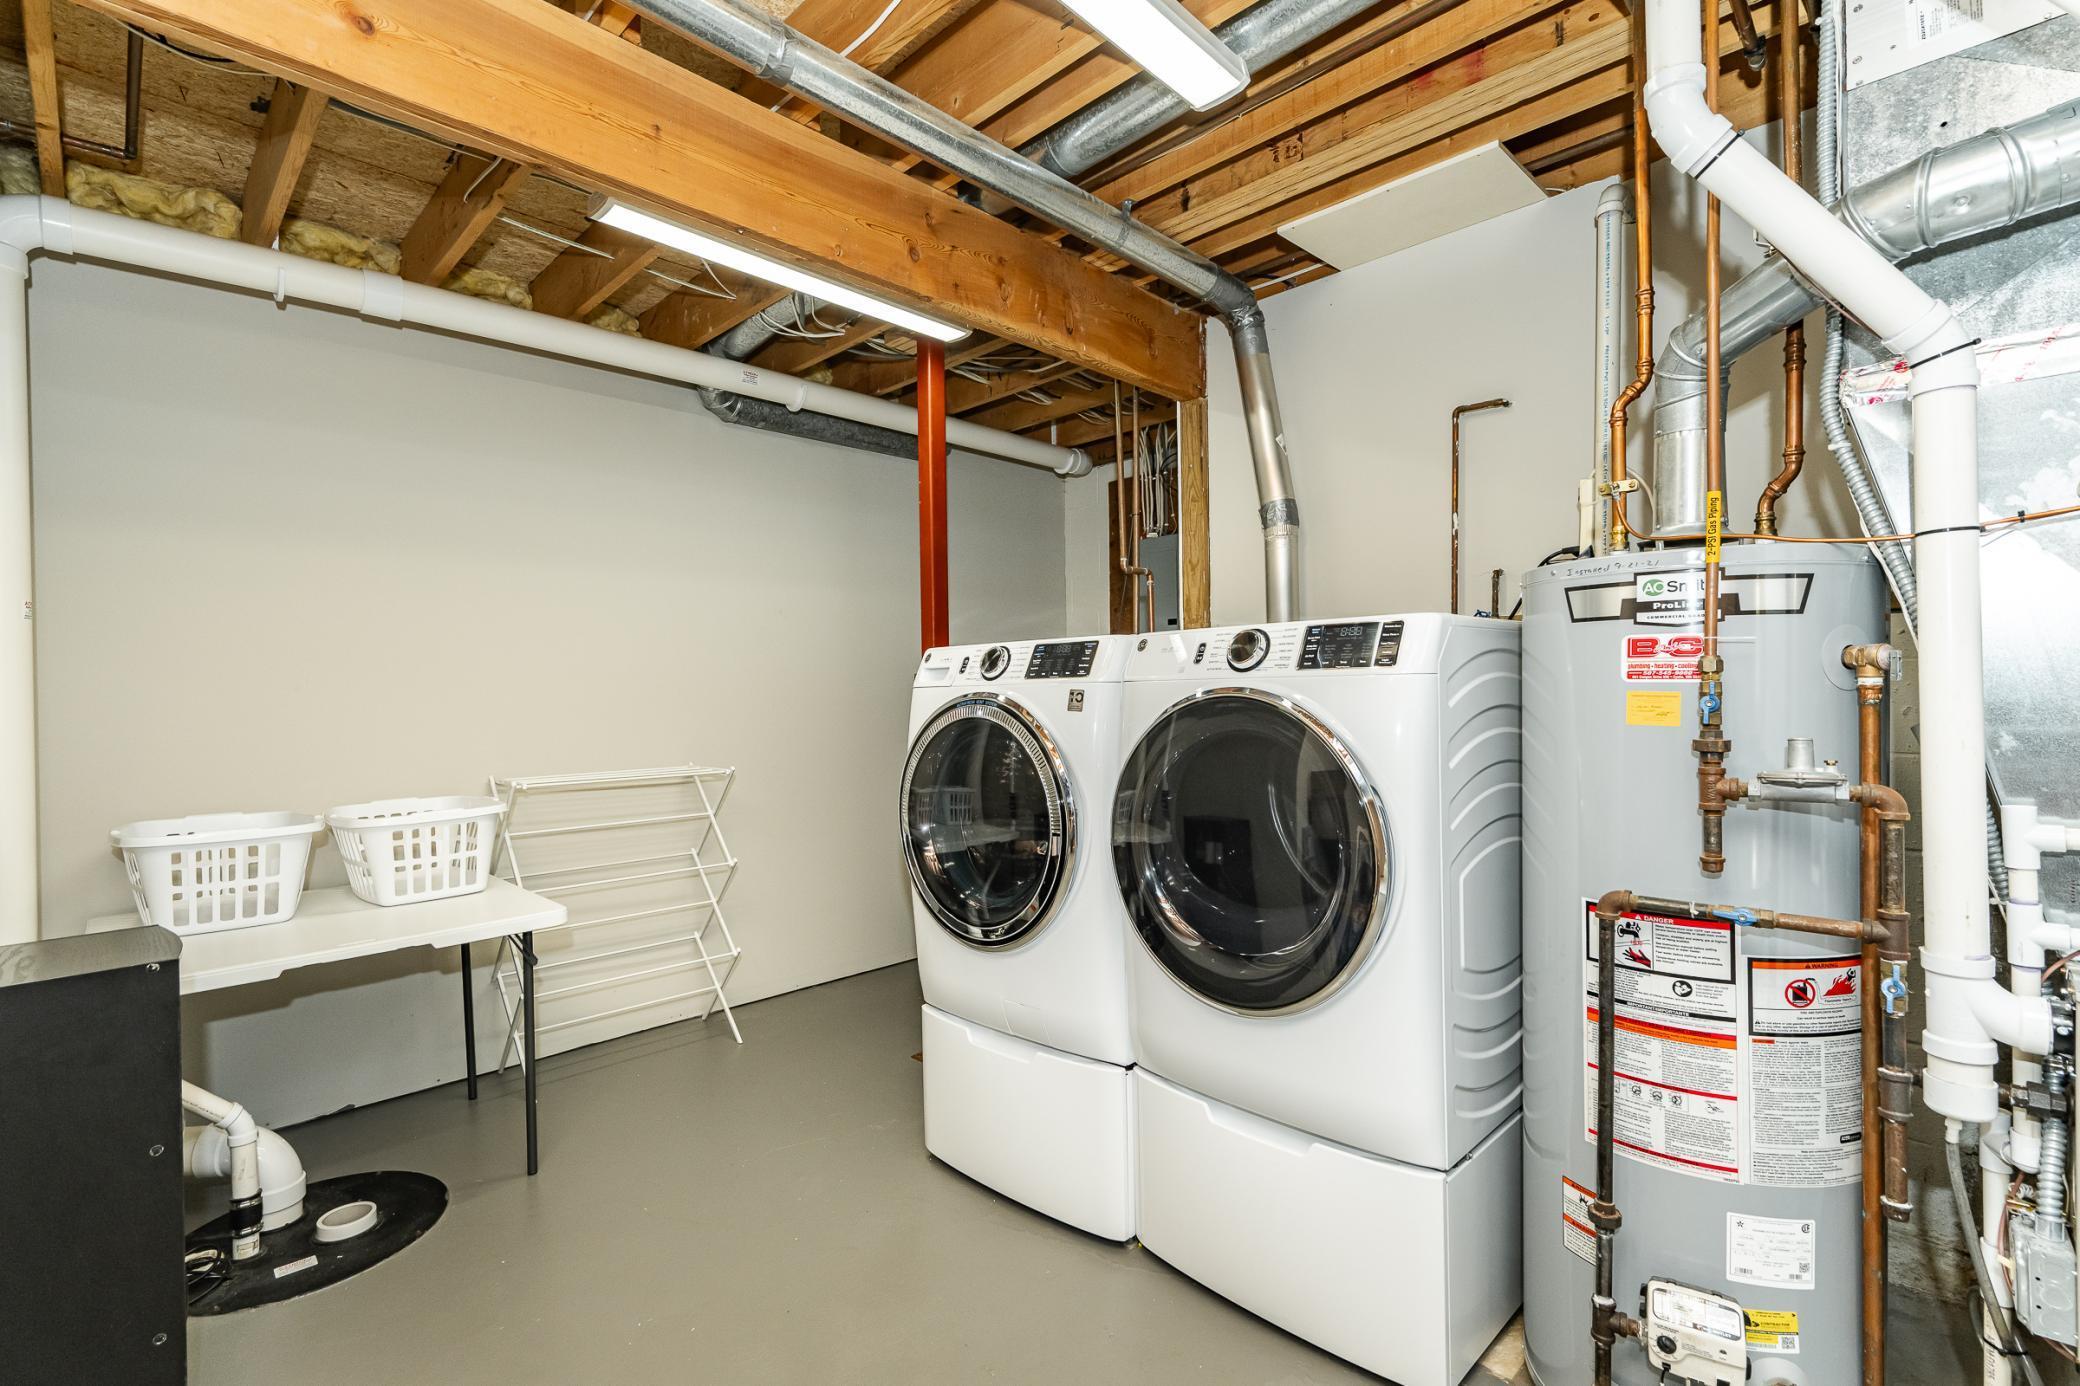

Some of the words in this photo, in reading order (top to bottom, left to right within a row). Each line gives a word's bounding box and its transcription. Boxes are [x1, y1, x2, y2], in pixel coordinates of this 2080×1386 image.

[1708, 497, 1720, 519] Piping
[1707, 519, 1717, 535] Gas
[1707, 535, 1716, 556] 2-PSI
[1643, 915, 1674, 925] DANGER
